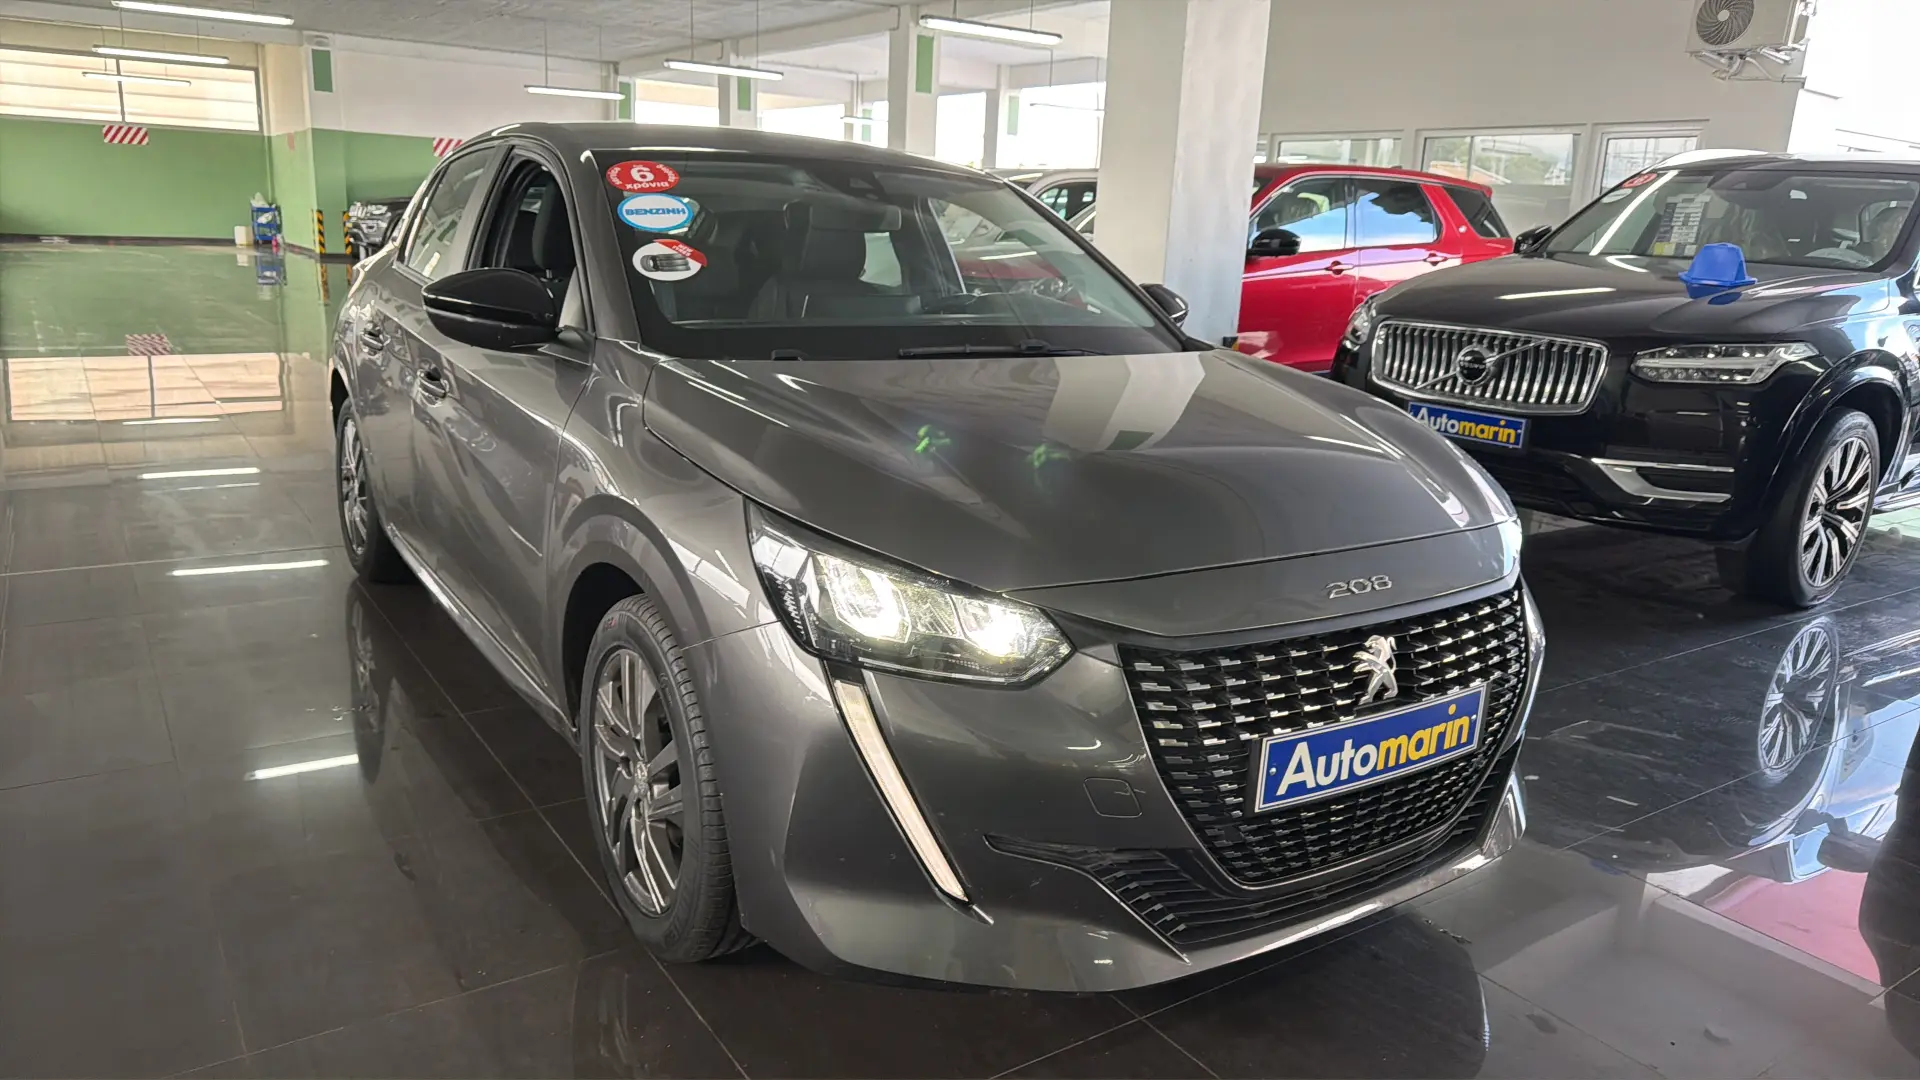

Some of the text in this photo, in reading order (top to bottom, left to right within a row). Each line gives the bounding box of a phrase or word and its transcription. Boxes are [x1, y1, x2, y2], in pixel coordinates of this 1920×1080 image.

[625, 181, 669, 190] χρόνια
[630, 166, 654, 182] 6
[1416, 407, 1517, 443] Automarin
[1325, 574, 1393, 599] 208
[1275, 703, 1470, 796] Automarin
